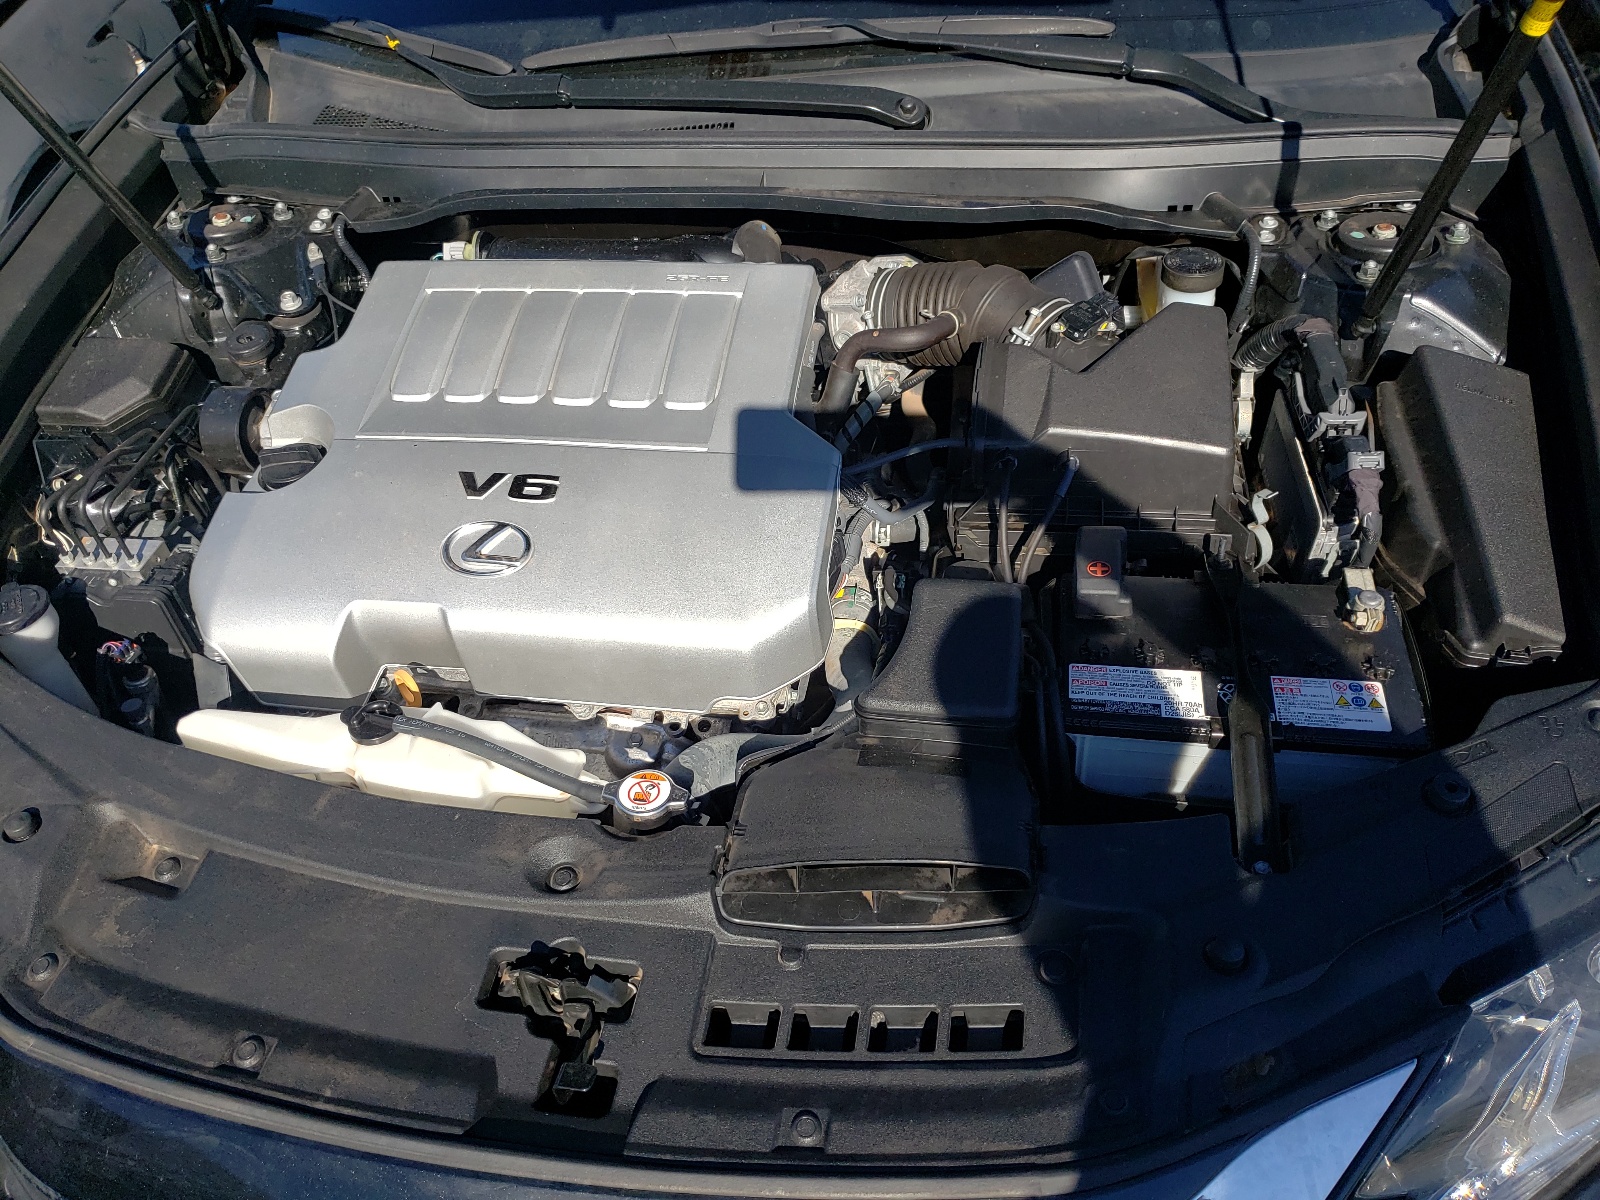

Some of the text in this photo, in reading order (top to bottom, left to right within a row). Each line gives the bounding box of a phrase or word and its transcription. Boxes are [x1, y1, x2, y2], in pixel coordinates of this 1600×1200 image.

[458, 471, 561, 503] V6
[1078, 665, 1107, 673] DANGER
[1078, 679, 1107, 687] POISON
